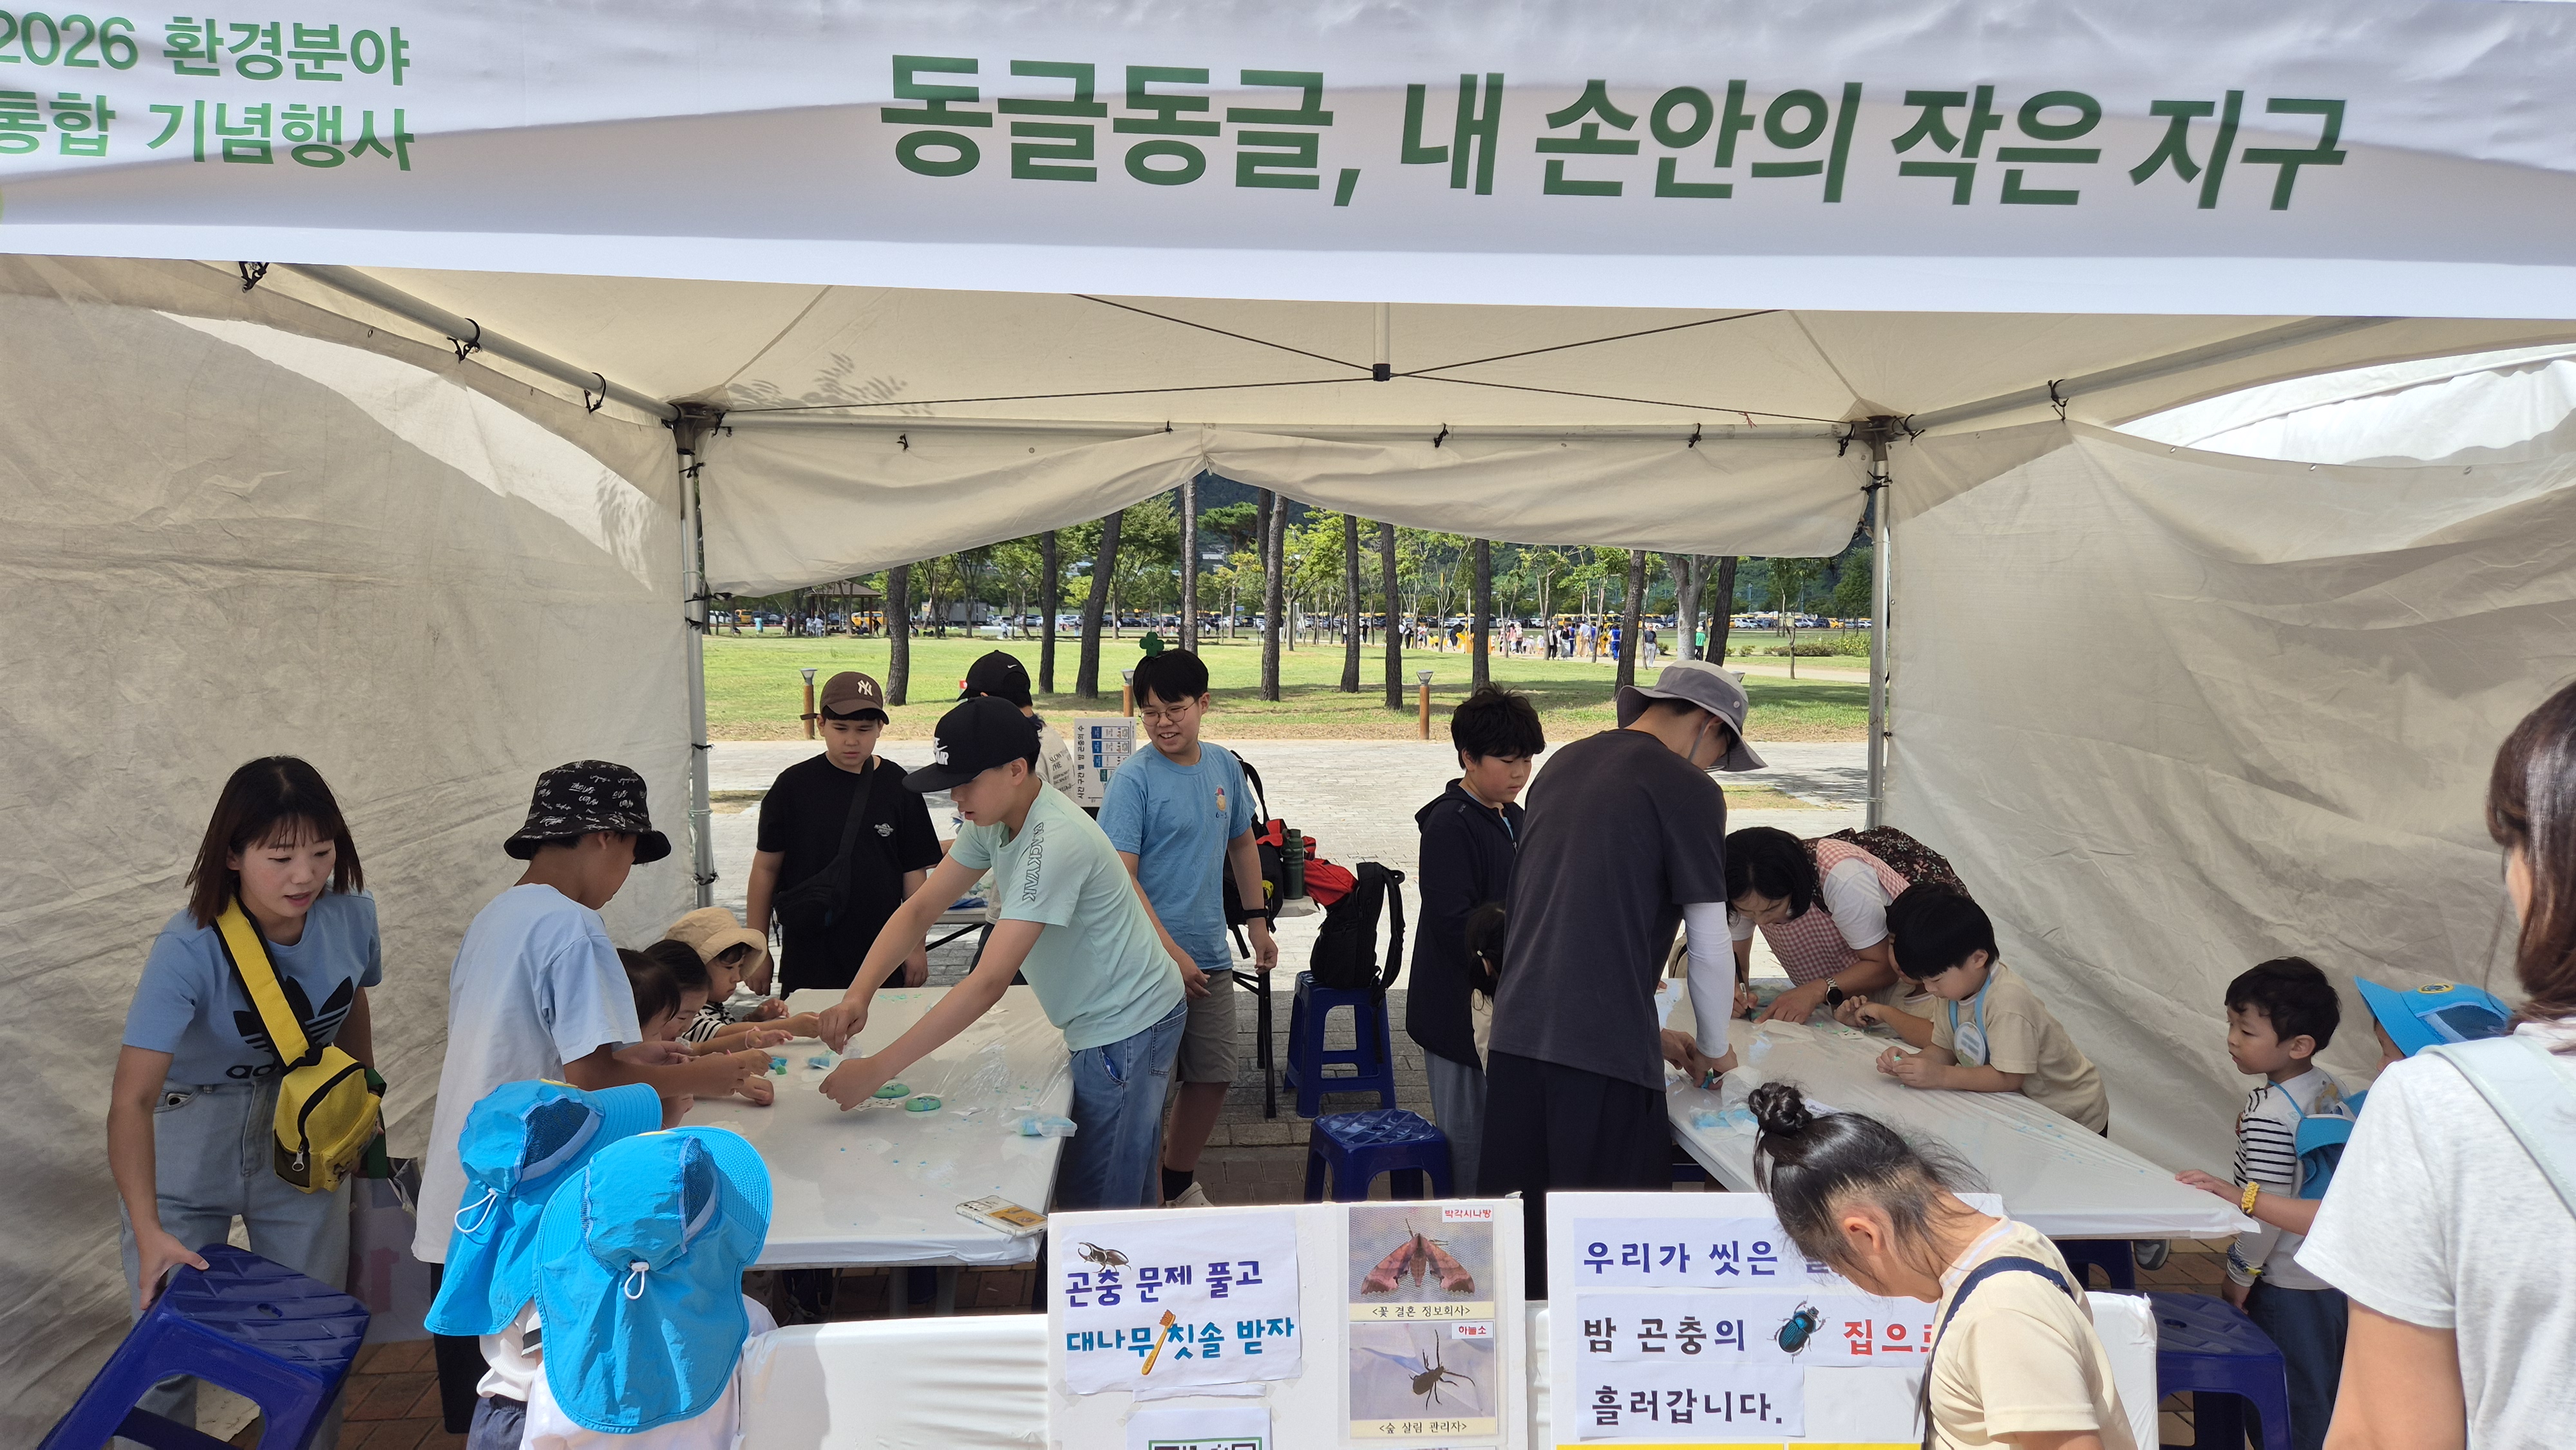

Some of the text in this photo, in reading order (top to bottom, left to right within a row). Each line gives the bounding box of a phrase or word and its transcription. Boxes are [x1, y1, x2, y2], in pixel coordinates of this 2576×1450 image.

[163, 16, 410, 86] 환경분야
[0, 90, 414, 171] 통합 기념행사
[880, 55, 2347, 211] 동글동글, 내 손안의 작은 지구
[1077, 772, 1084, 785] 구간
[1077, 786, 1084, 799] 시간
[1444, 1209, 1492, 1219] 박각시나방
[1583, 1241, 1690, 1274] 우리가
[1708, 1240, 1778, 1276] 씻은
[1065, 1260, 1263, 1308] 곤충 문제 풀고
[1394, 1306, 1416, 1317] 결혼
[1457, 1325, 1487, 1336] 하늘소
[1066, 1317, 1295, 1361] 대나무 칫솔 받자
[1584, 1317, 1617, 1353] 밤
[1637, 1315, 1745, 1355] 곤충의
[1592, 1385, 1783, 1426] 흘러갑니다.
[1401, 1422, 1423, 1434] 살림
